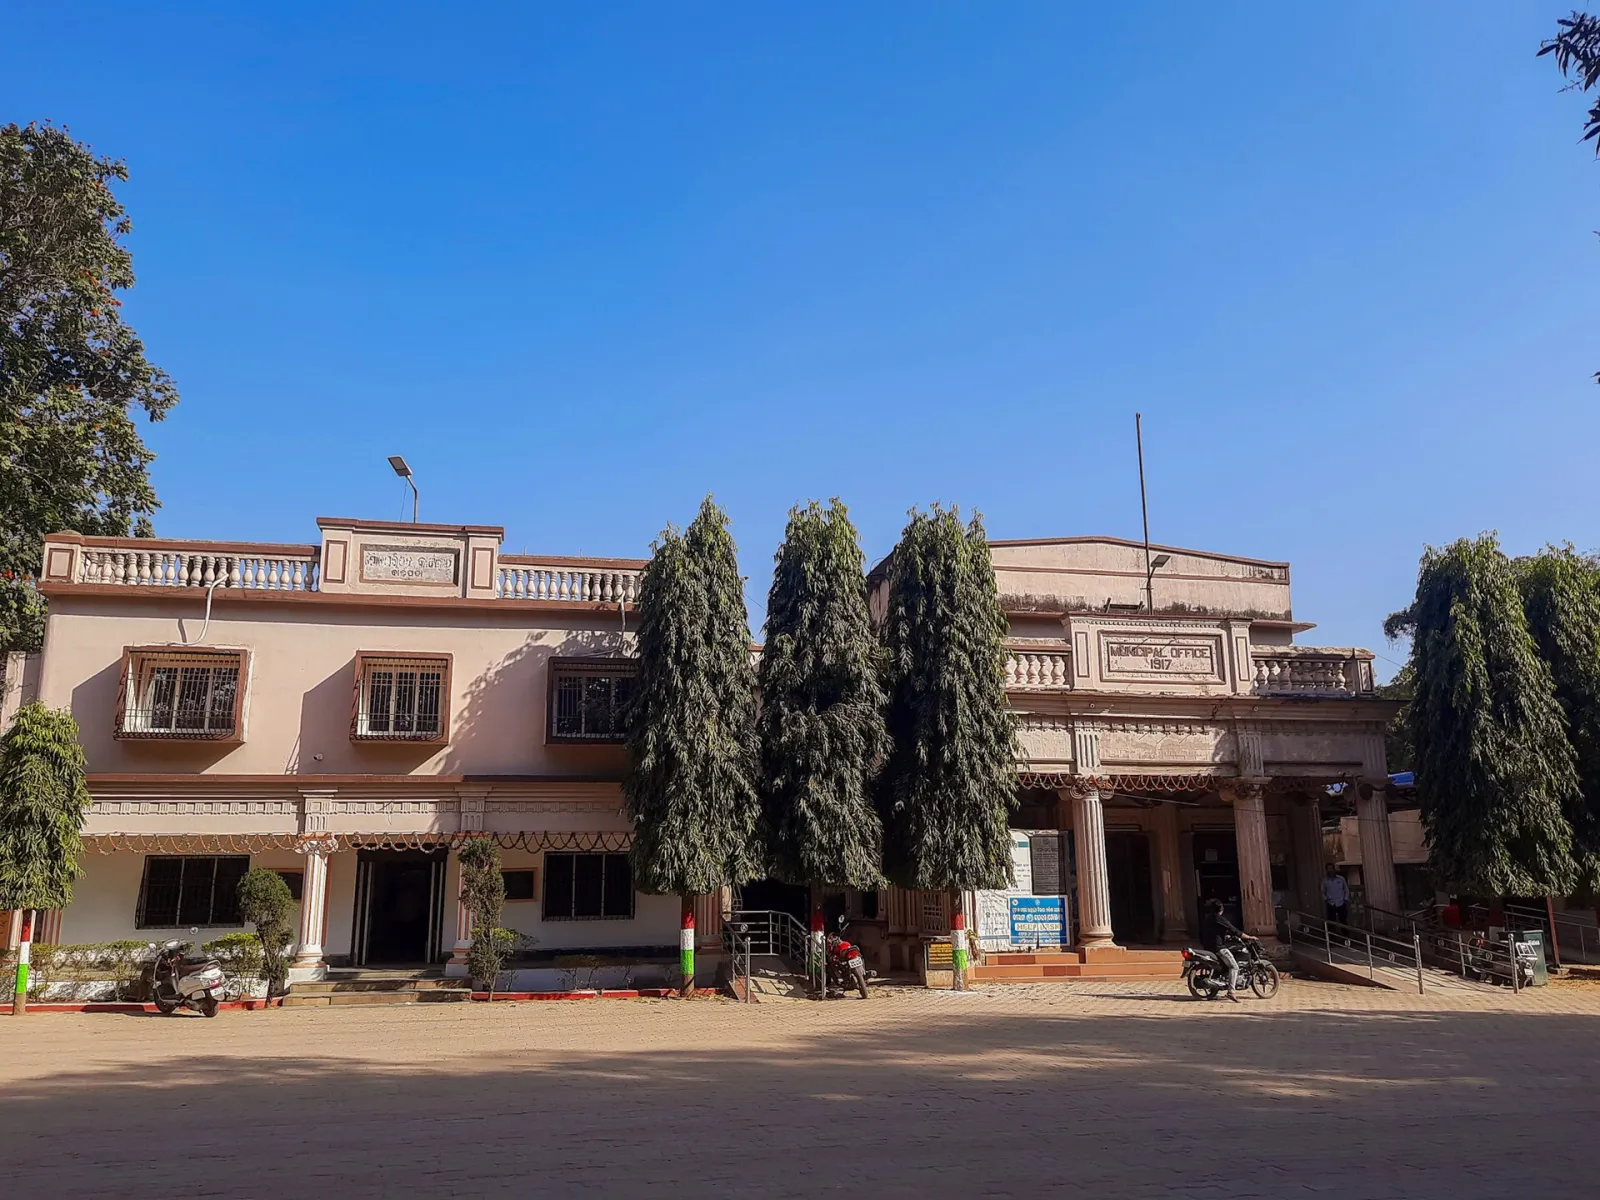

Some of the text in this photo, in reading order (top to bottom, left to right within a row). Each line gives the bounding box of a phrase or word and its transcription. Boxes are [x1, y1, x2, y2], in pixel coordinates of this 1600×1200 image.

[1110, 645, 1210, 659] MUNICIPAL OFFICE
[1150, 658, 1173, 670] 1917
